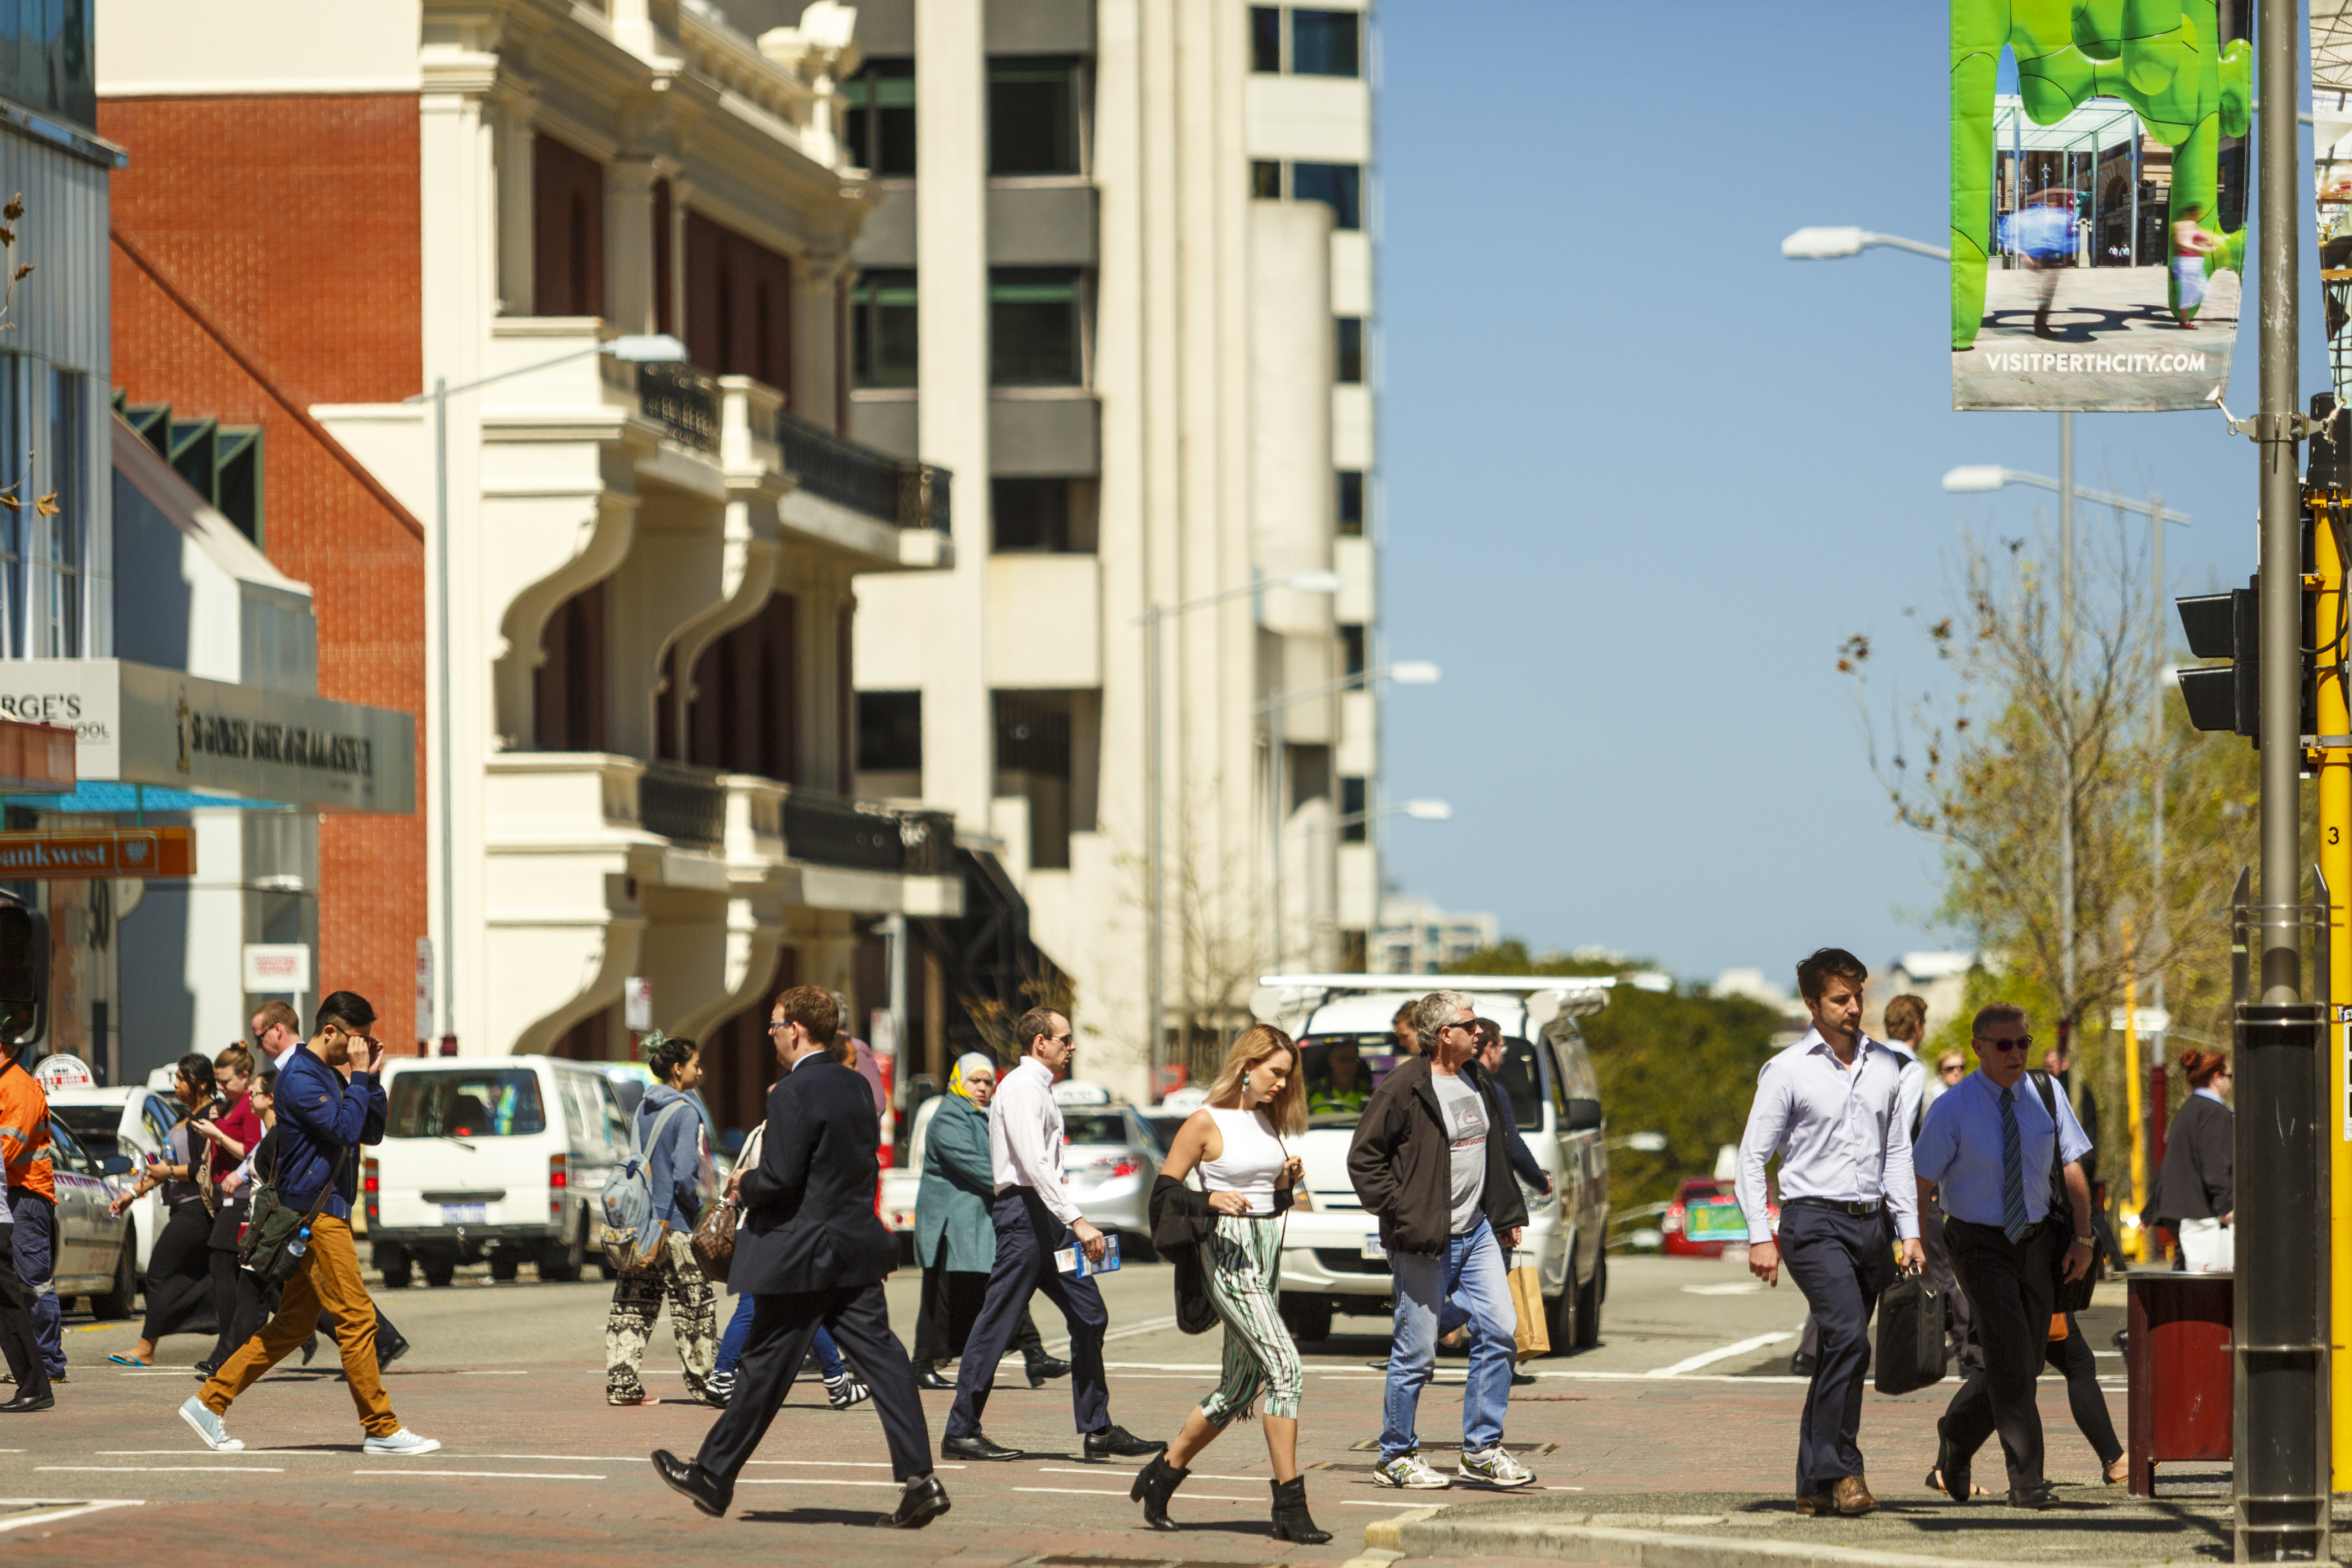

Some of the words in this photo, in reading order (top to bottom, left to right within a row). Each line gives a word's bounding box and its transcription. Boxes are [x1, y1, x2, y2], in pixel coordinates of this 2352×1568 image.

[1985, 353, 2205, 373] VISITPERTHCITY.COM
[2328, 826, 2339, 845] 3
[0, 842, 107, 867] ankwest
[1456, 1135, 1485, 1147] QUIKSILVER
